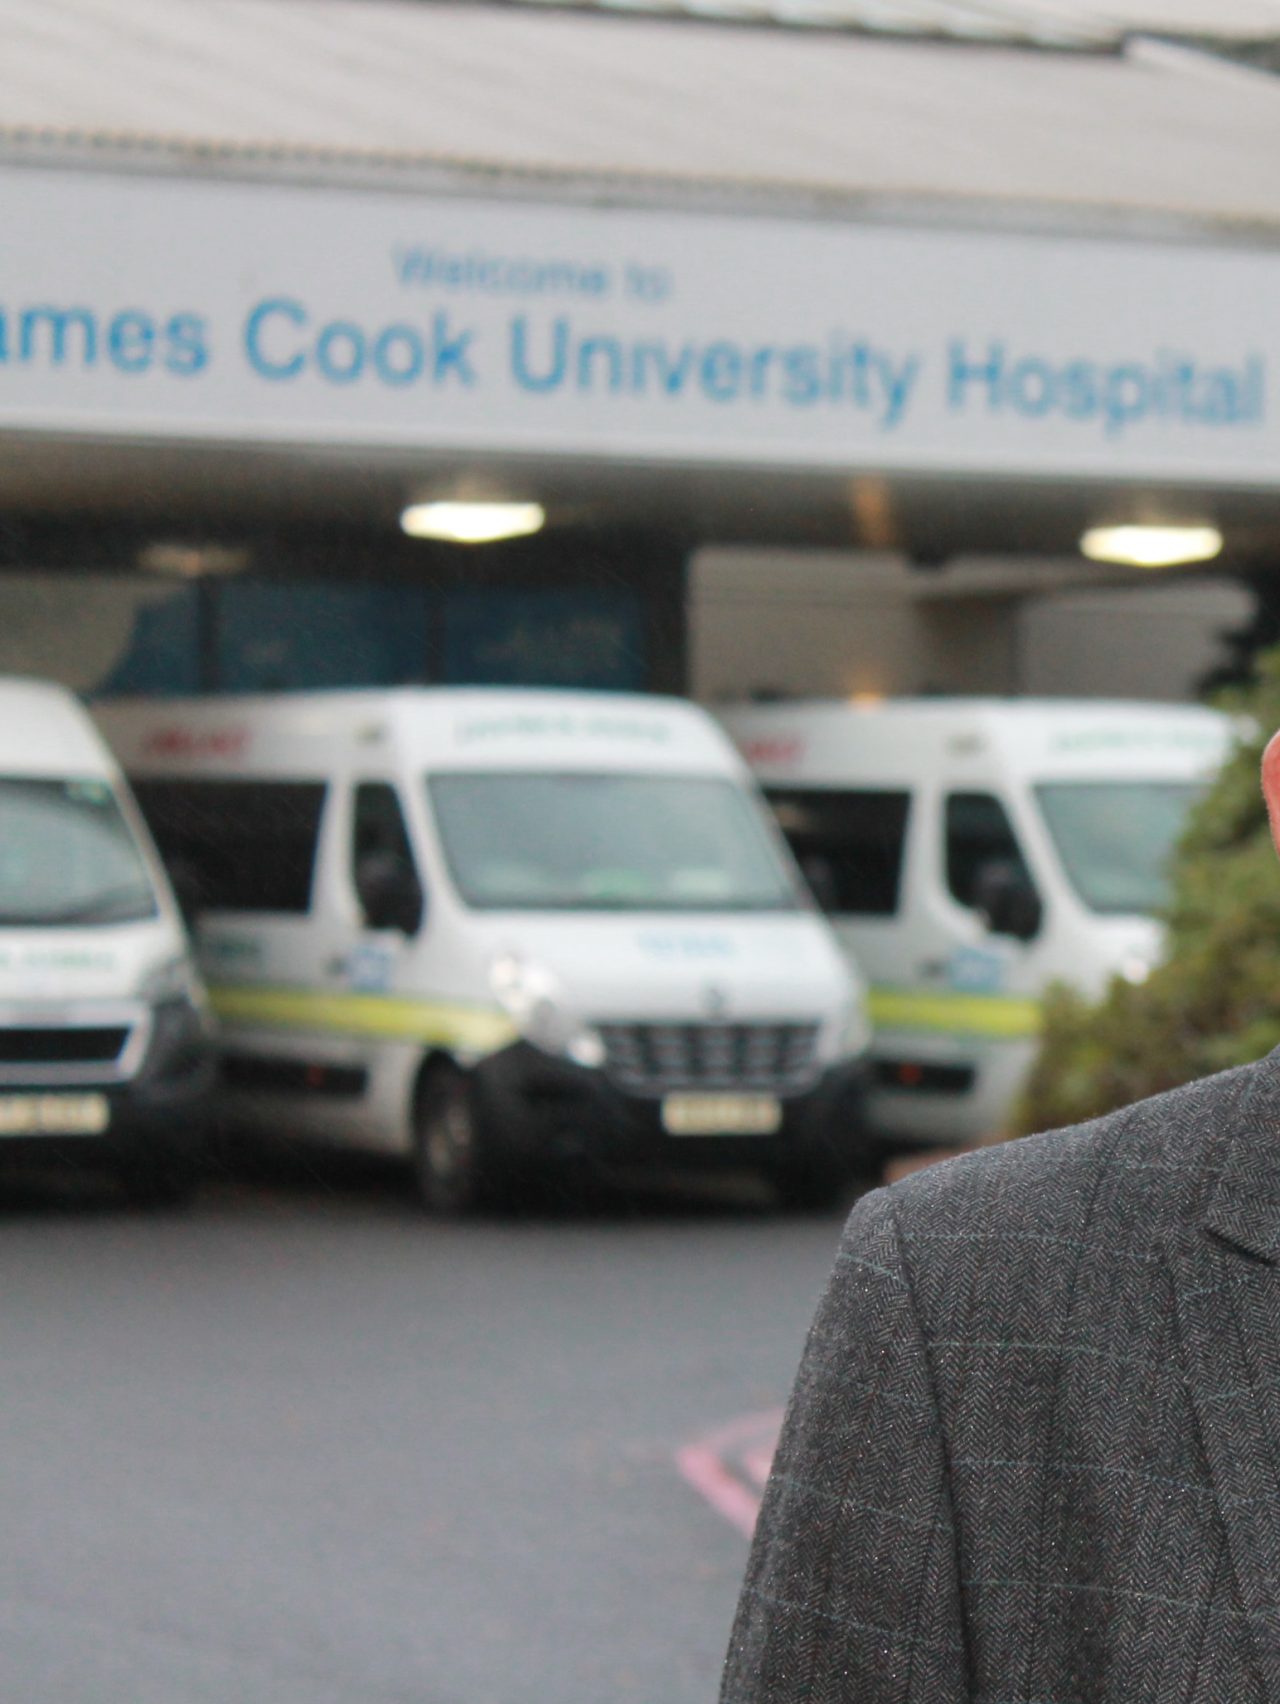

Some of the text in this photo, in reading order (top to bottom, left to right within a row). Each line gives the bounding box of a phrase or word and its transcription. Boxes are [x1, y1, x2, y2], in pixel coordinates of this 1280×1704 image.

[392, 243, 672, 303] Welcome to
[0, 297, 1264, 435] mes Cook University Hospital
